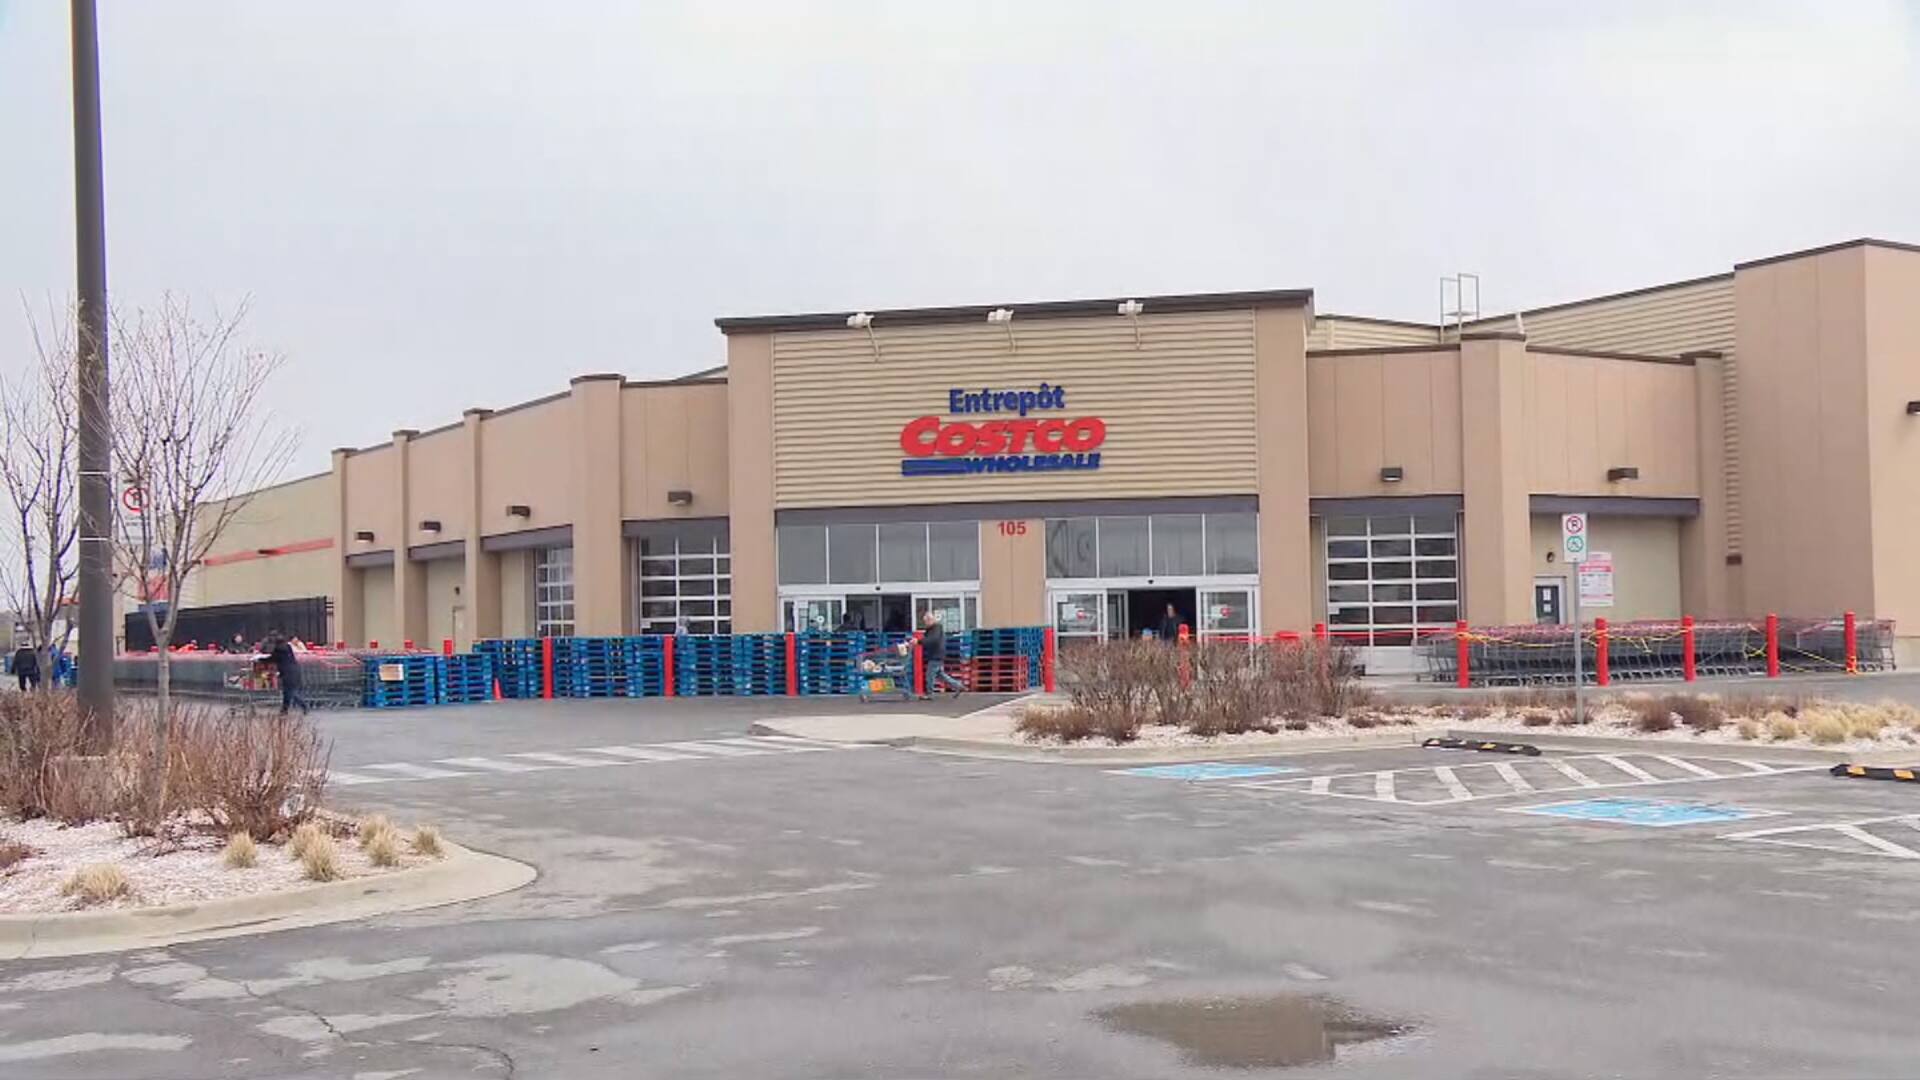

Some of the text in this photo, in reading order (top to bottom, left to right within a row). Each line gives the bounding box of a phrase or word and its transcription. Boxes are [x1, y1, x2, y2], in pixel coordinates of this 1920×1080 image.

[949, 382, 1065, 416] Entrepôt
[900, 415, 1106, 457] COSTCO
[963, 453, 1101, 474] WHOLESALE
[997, 521, 1026, 536] 105
